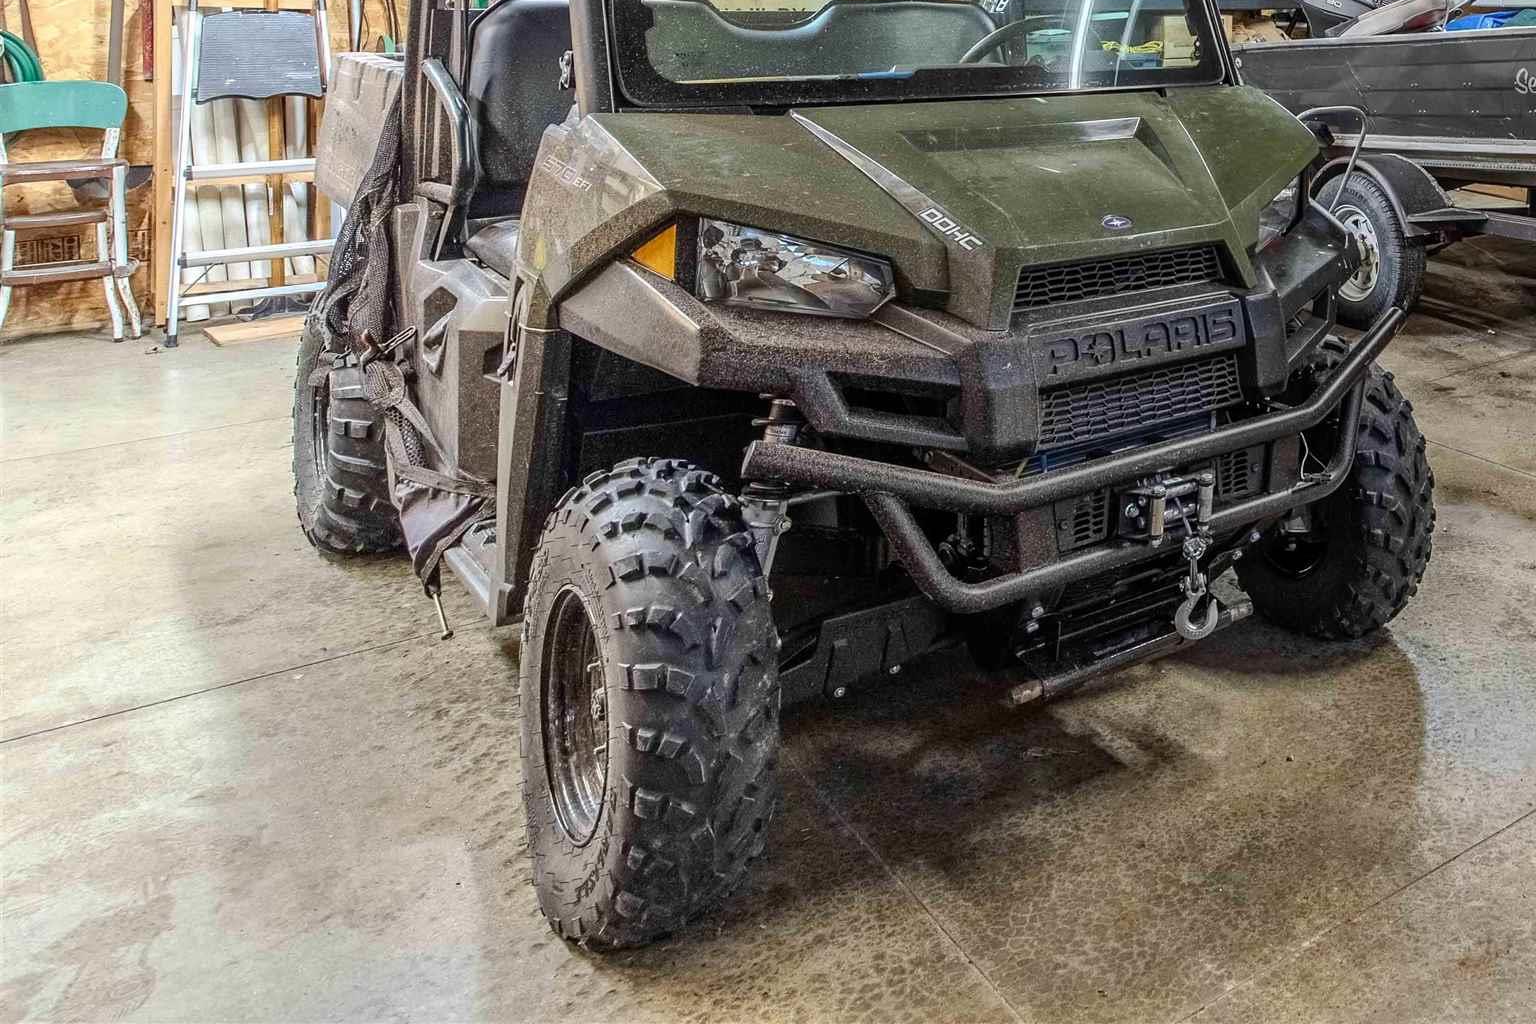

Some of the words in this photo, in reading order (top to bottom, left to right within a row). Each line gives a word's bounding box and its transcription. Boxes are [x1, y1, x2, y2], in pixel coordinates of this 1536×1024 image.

[541, 154, 577, 185] 570
[918, 207, 984, 252] DOHC
[1043, 308, 1238, 376] POLARIS
